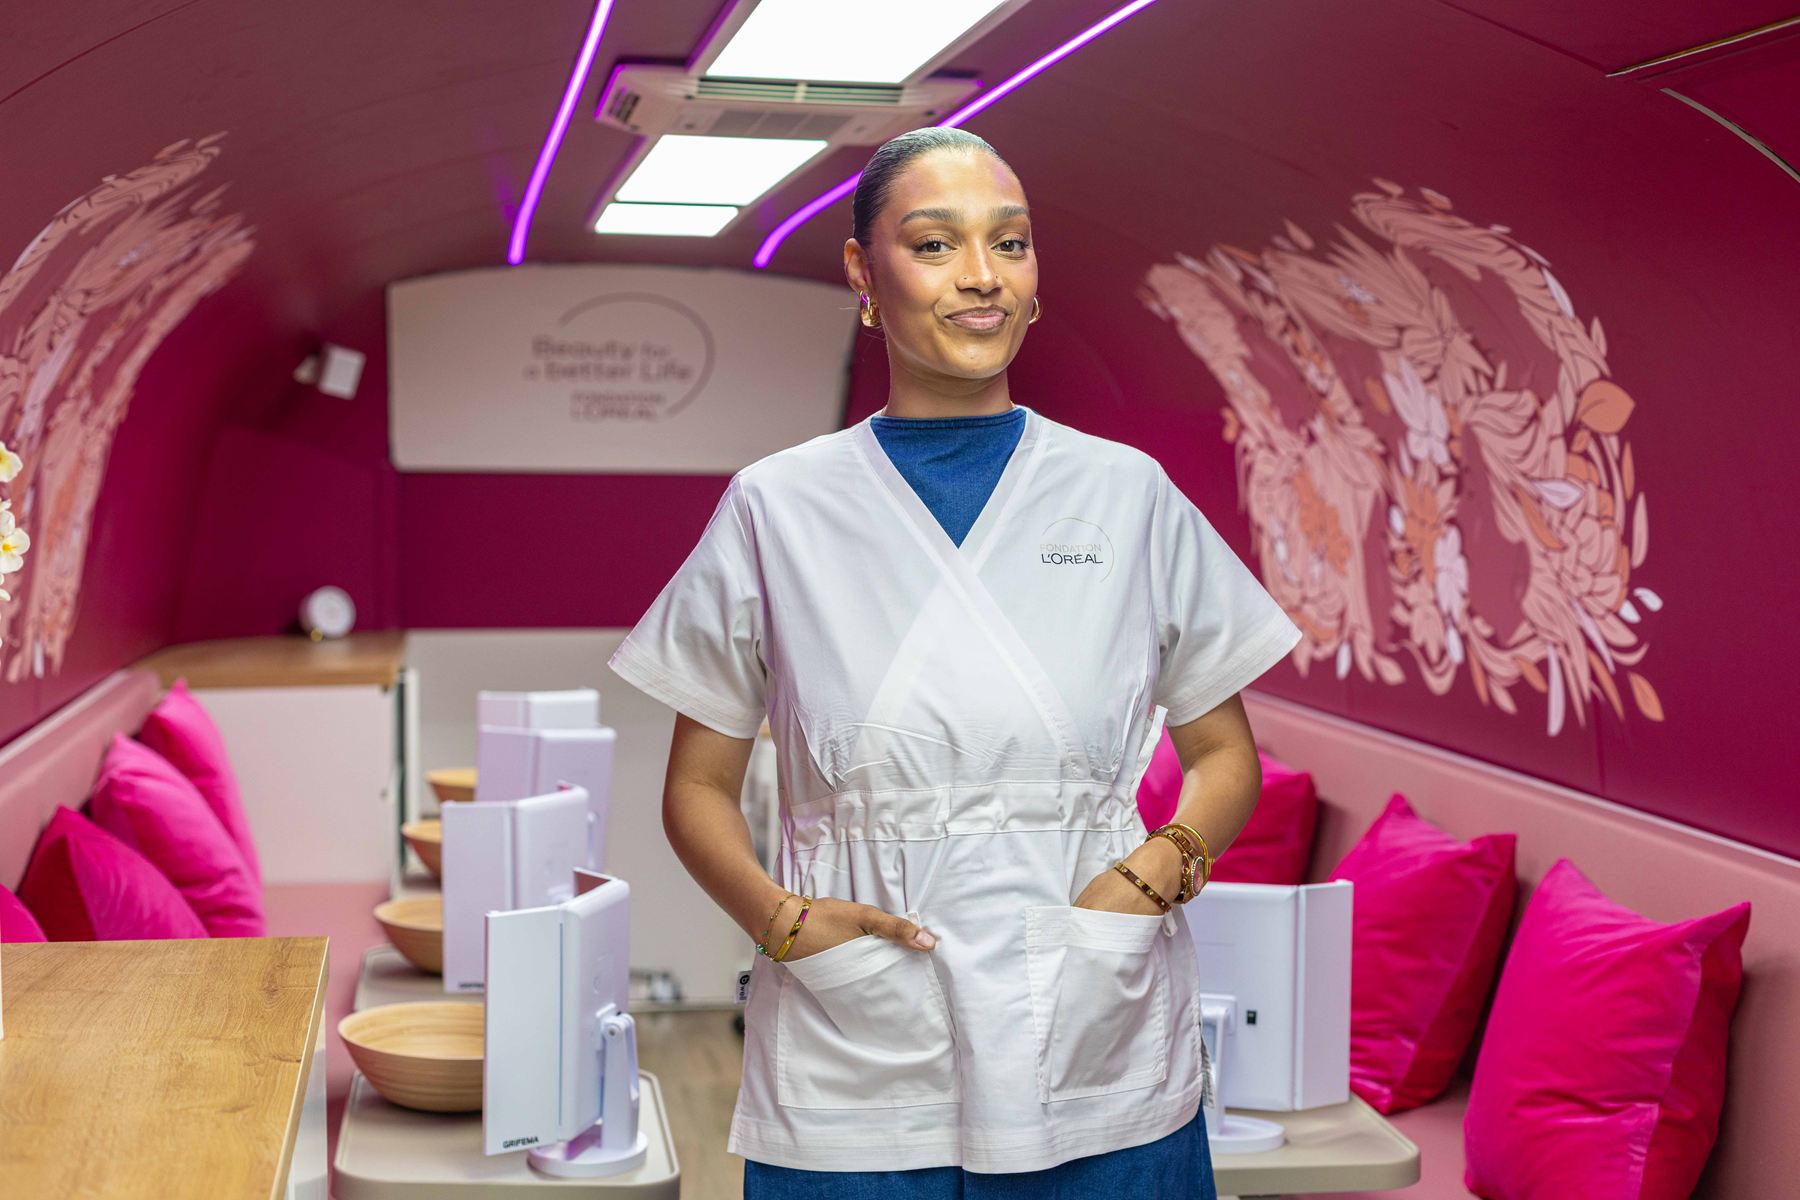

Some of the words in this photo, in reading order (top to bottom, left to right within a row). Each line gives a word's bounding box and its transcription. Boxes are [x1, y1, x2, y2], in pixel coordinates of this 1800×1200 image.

[532, 335, 636, 361] Beauty
[545, 362, 633, 381] better
[1040, 543, 1102, 553] FONDATION
[1041, 553, 1103, 565] L'ORÉAL
